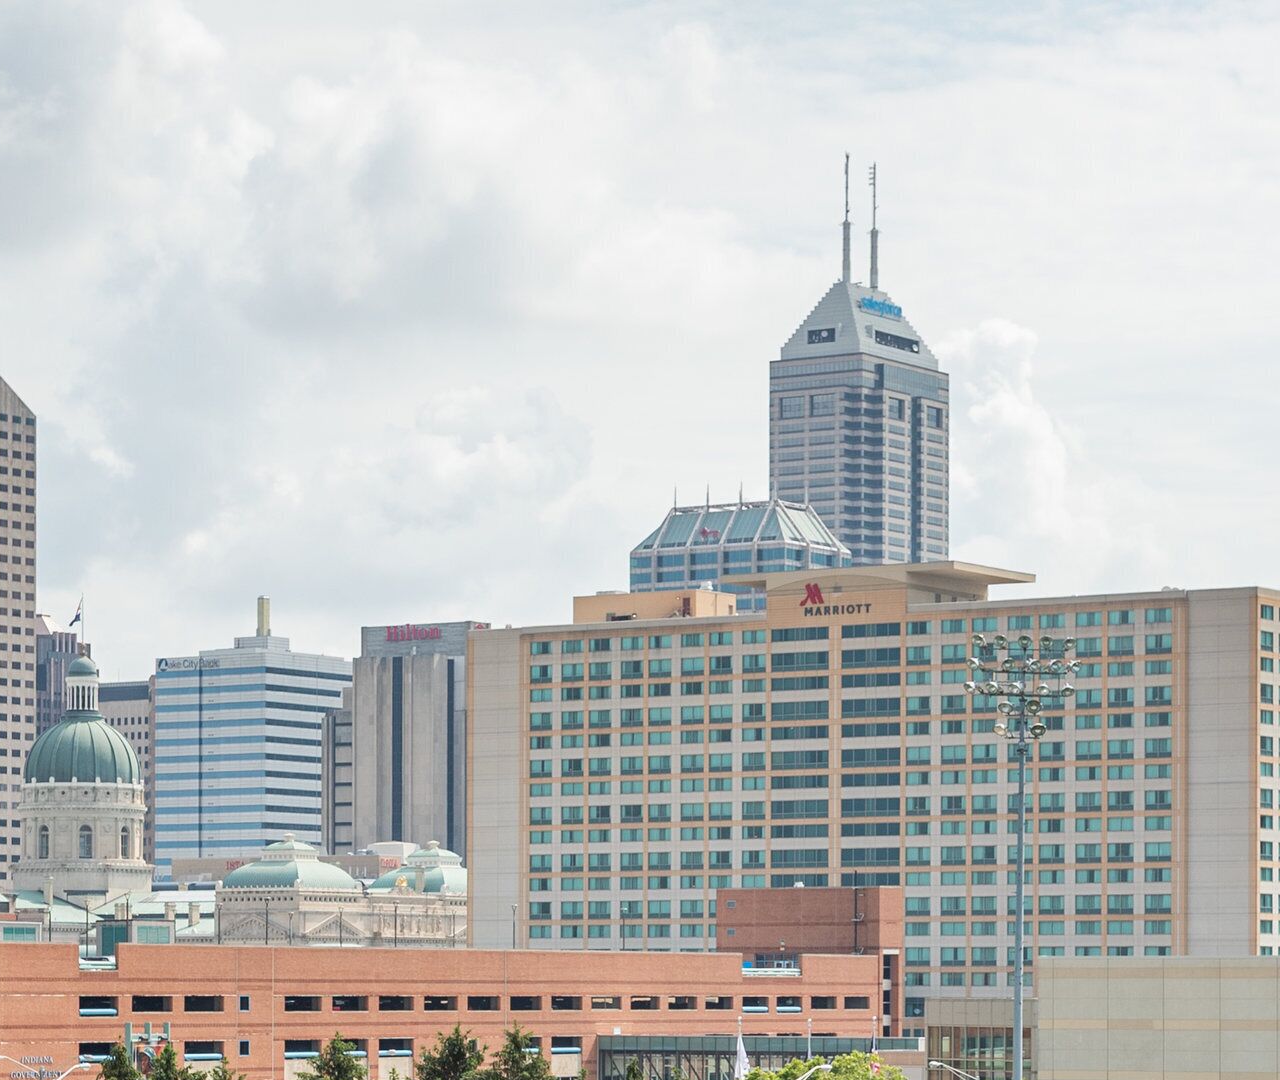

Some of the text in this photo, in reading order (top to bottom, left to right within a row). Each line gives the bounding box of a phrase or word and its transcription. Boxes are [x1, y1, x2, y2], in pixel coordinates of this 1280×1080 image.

[804, 603, 872, 616] MARRIOTT
[386, 623, 440, 641] Hilton
[21, 1055, 54, 1065] INDIANA
